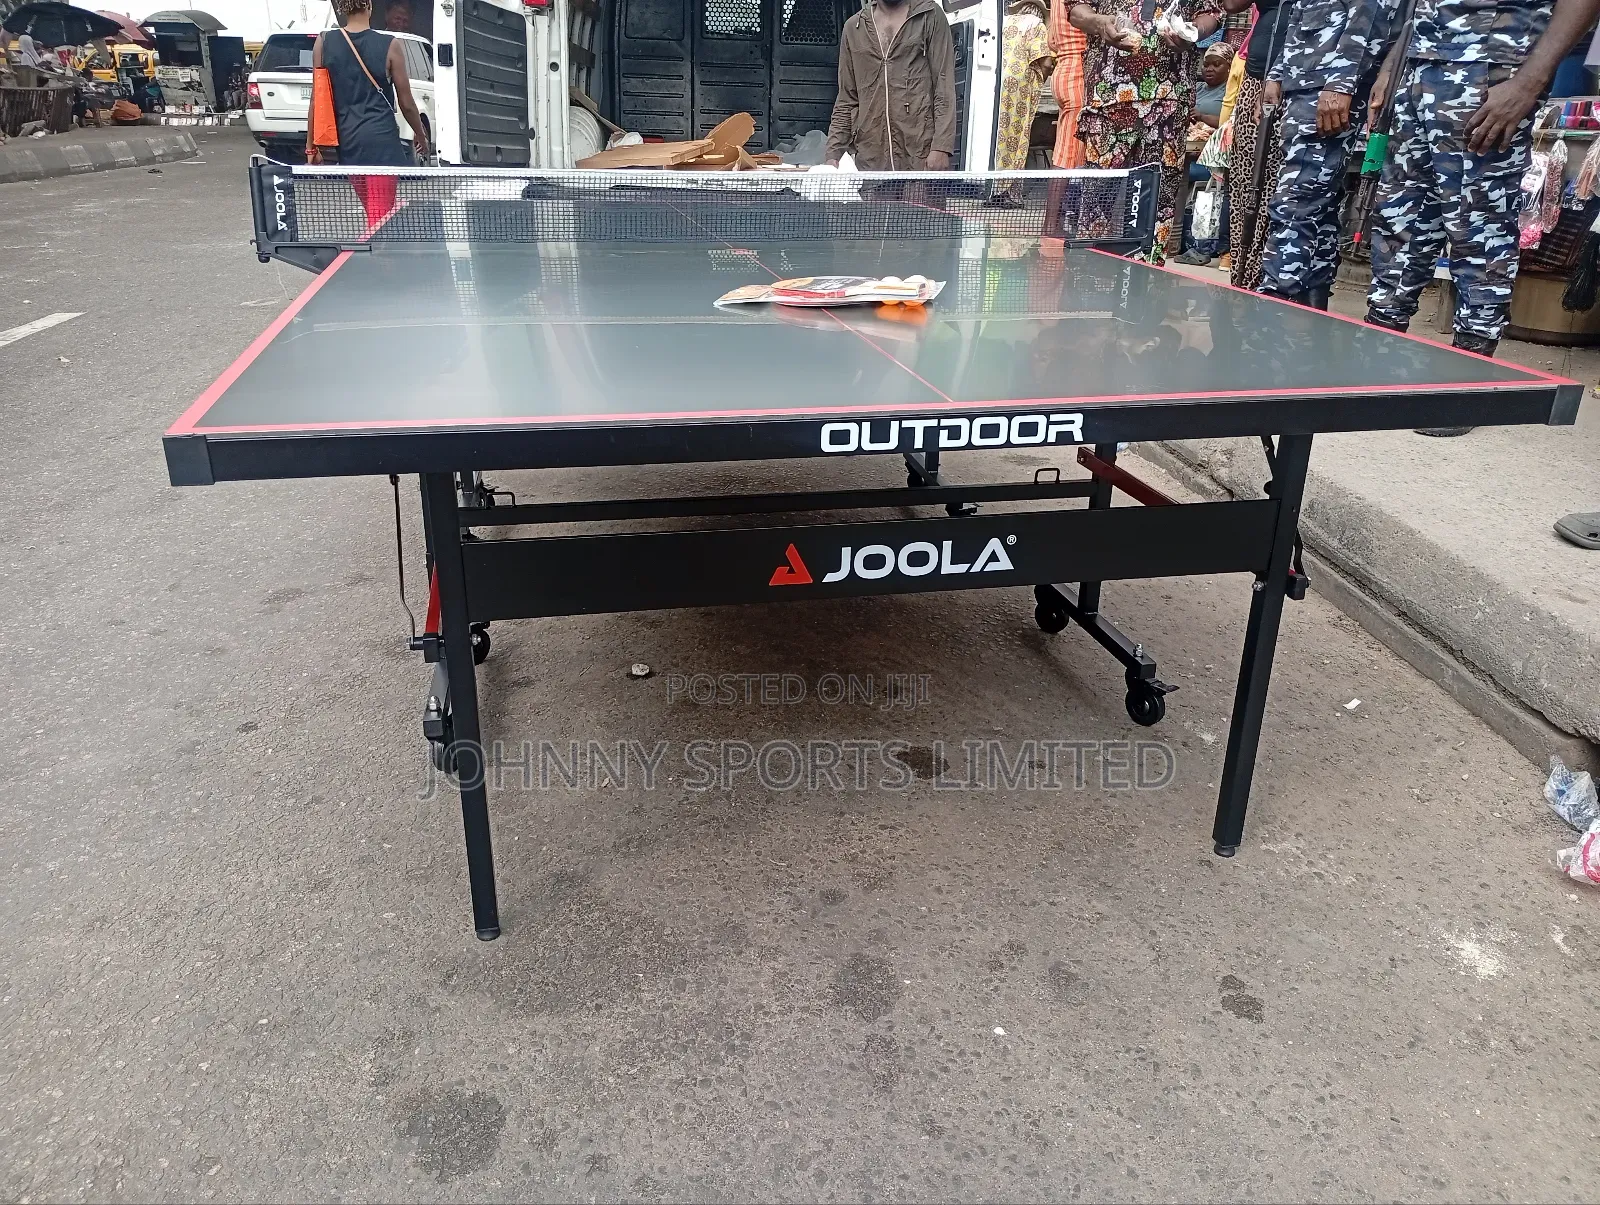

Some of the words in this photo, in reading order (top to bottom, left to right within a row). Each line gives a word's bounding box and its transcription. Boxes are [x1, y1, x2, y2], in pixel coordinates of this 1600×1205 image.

[273, 186, 287, 230] JOOLA
[1131, 179, 1142, 218] JOOLA
[820, 412, 1084, 453] OUTDOOR
